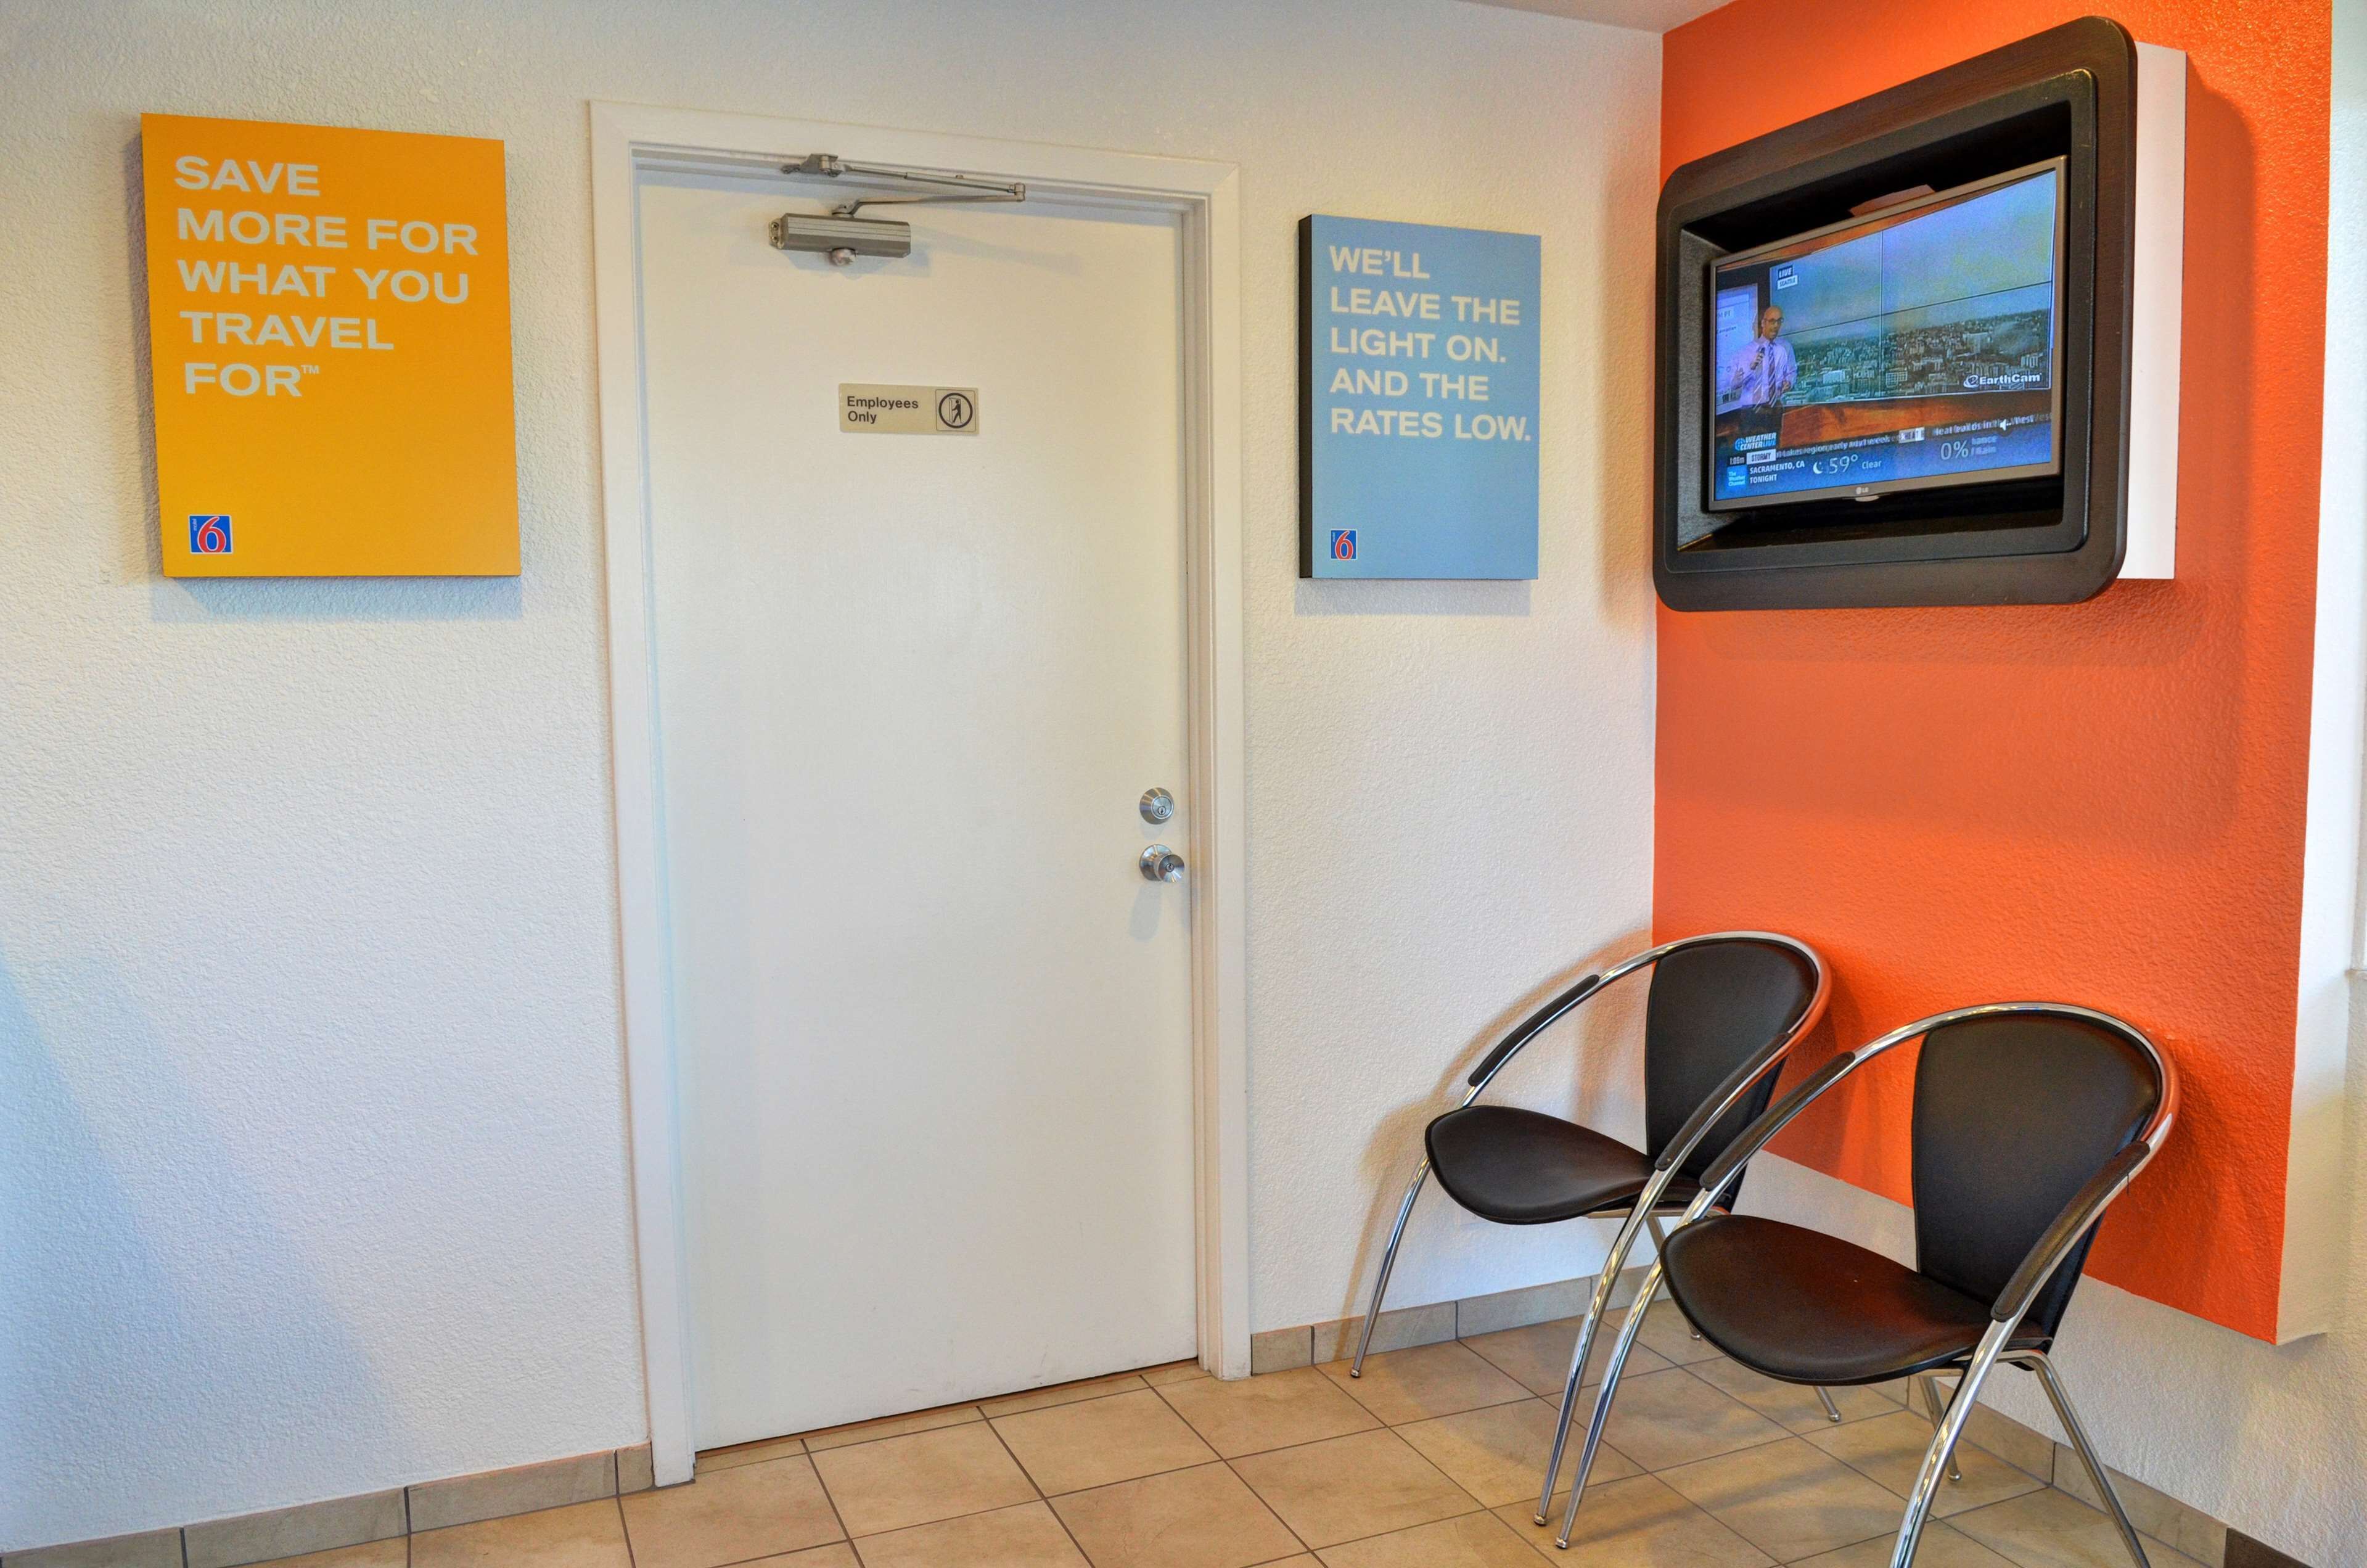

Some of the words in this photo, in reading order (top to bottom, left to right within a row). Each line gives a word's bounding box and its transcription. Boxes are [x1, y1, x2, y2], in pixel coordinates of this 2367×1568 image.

[175, 155, 320, 196] SAVE
[178, 207, 348, 248] MORE
[367, 219, 478, 255] FOR
[1327, 244, 1431, 280] WE'LL
[1779, 266, 1792, 278] LIVE
[177, 260, 336, 297] WHAT
[354, 268, 469, 304] YOU
[1329, 285, 1441, 320] LEAVE
[1450, 295, 1521, 326] THE
[179, 311, 394, 350] TRAVEL
[1330, 326, 1437, 359] LIGHT
[1446, 334, 1508, 364] ON.
[1329, 367, 1409, 397] AND
[1419, 372, 1490, 401] THE
[1979, 373, 2041, 385] EarthCam
[847, 395, 919, 411] Employees
[847, 410, 877, 425] Only
[1331, 407, 1443, 438] RATES
[1455, 414, 1532, 441] LOW.
[1739, 440, 1763, 451] CENTER
[1746, 432, 1776, 443] WEATHER
[1940, 439, 1969, 461] 0%
[1749, 461, 1795, 475] SACRAMENTO,
[1795, 461, 1805, 469] CA
[1828, 454, 1858, 474] 59°
[1861, 459, 1882, 470] Clear
[1750, 474, 1778, 484] TONIGHT
[197, 516, 227, 553] 6
[1335, 530, 1354, 560] 6
